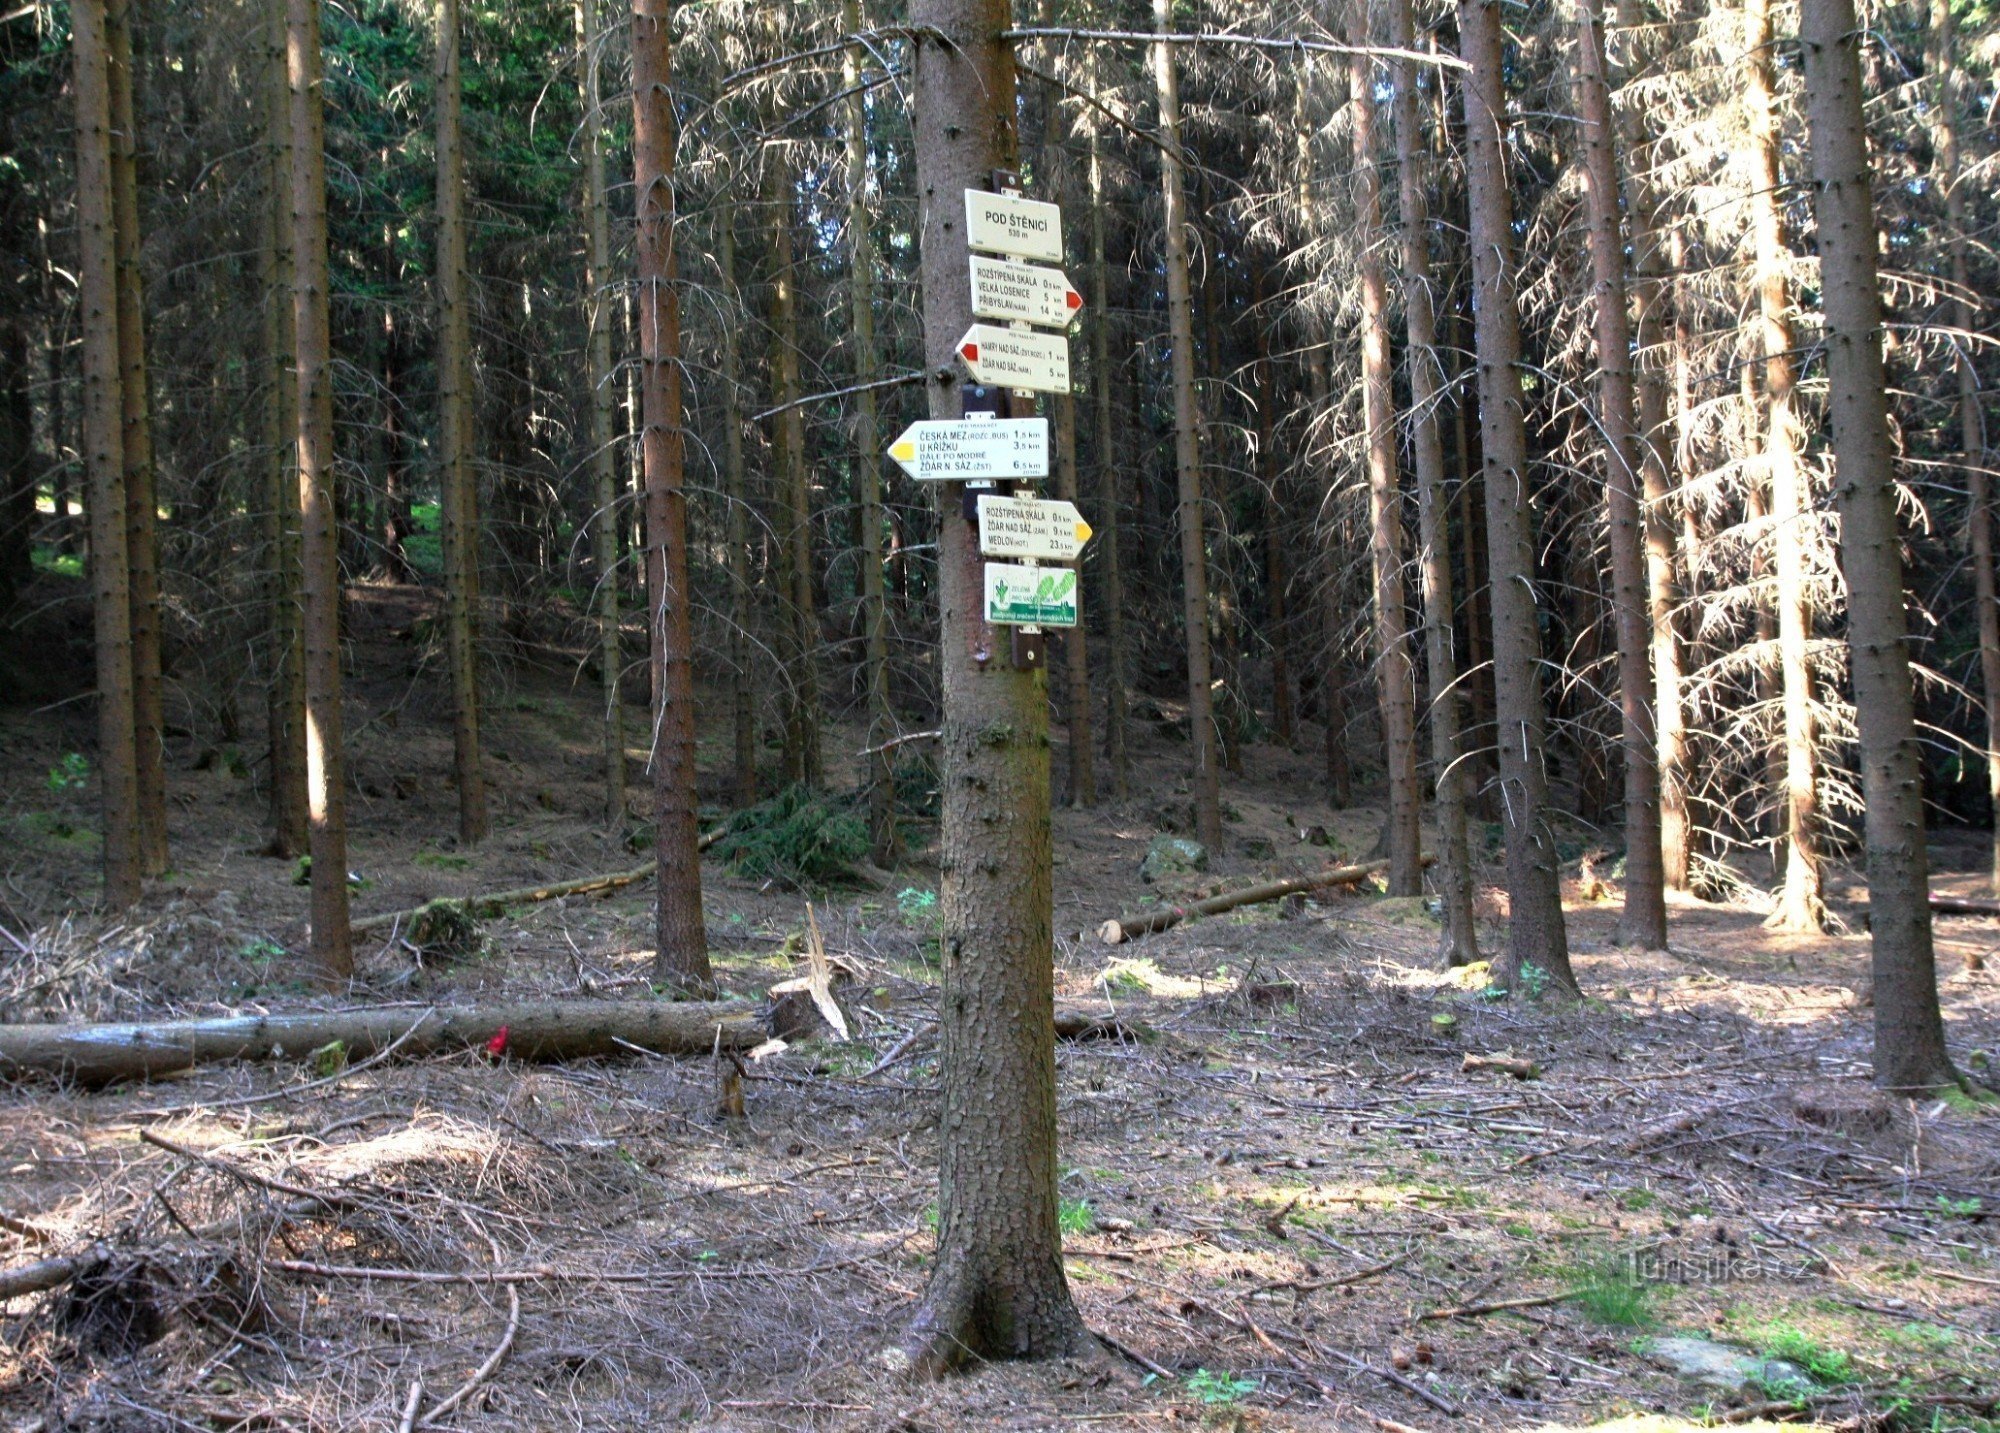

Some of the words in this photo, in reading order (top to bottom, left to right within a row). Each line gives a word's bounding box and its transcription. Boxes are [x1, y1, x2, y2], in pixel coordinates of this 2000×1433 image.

[986, 210, 1006, 224] POD
[1010, 213, 1047, 232] ŠTĚNICÍ
[978, 267, 1015, 283] ROZŠTÍPENÁ
[1017, 274, 1037, 286] SKÁLA
[978, 281, 999, 294] VELKÁ
[1000, 284, 1030, 299] LOSENICE
[1044, 292, 1049, 302] 5
[1041, 305, 1049, 315] 14
[999, 343, 1009, 354] NAD
[1049, 350, 1052, 360] 1
[996, 359, 1007, 370] NAD
[1050, 367, 1054, 377] 5
[919, 430, 947, 442] ČESKÁ
[1014, 430, 1026, 440] 1,5
[1028, 431, 1041, 440] km
[919, 444, 926, 453] U
[928, 440, 959, 452] KŘÍŽKU
[1013, 441, 1026, 451] 3,5
[943, 453, 955, 461] PO
[957, 450, 987, 460] MODRÉ
[919, 459, 943, 472] ŽĎÁR
[1013, 460, 1026, 470] 6,5
[1028, 462, 1041, 471] km
[986, 507, 1024, 520] ROZŠTÍPENÁ
[1025, 510, 1045, 521] SKÁLA
[987, 520, 1004, 532] ŽĎÁR
[1005, 523, 1017, 533] NAD
[988, 535, 1013, 546] MEDLOV
